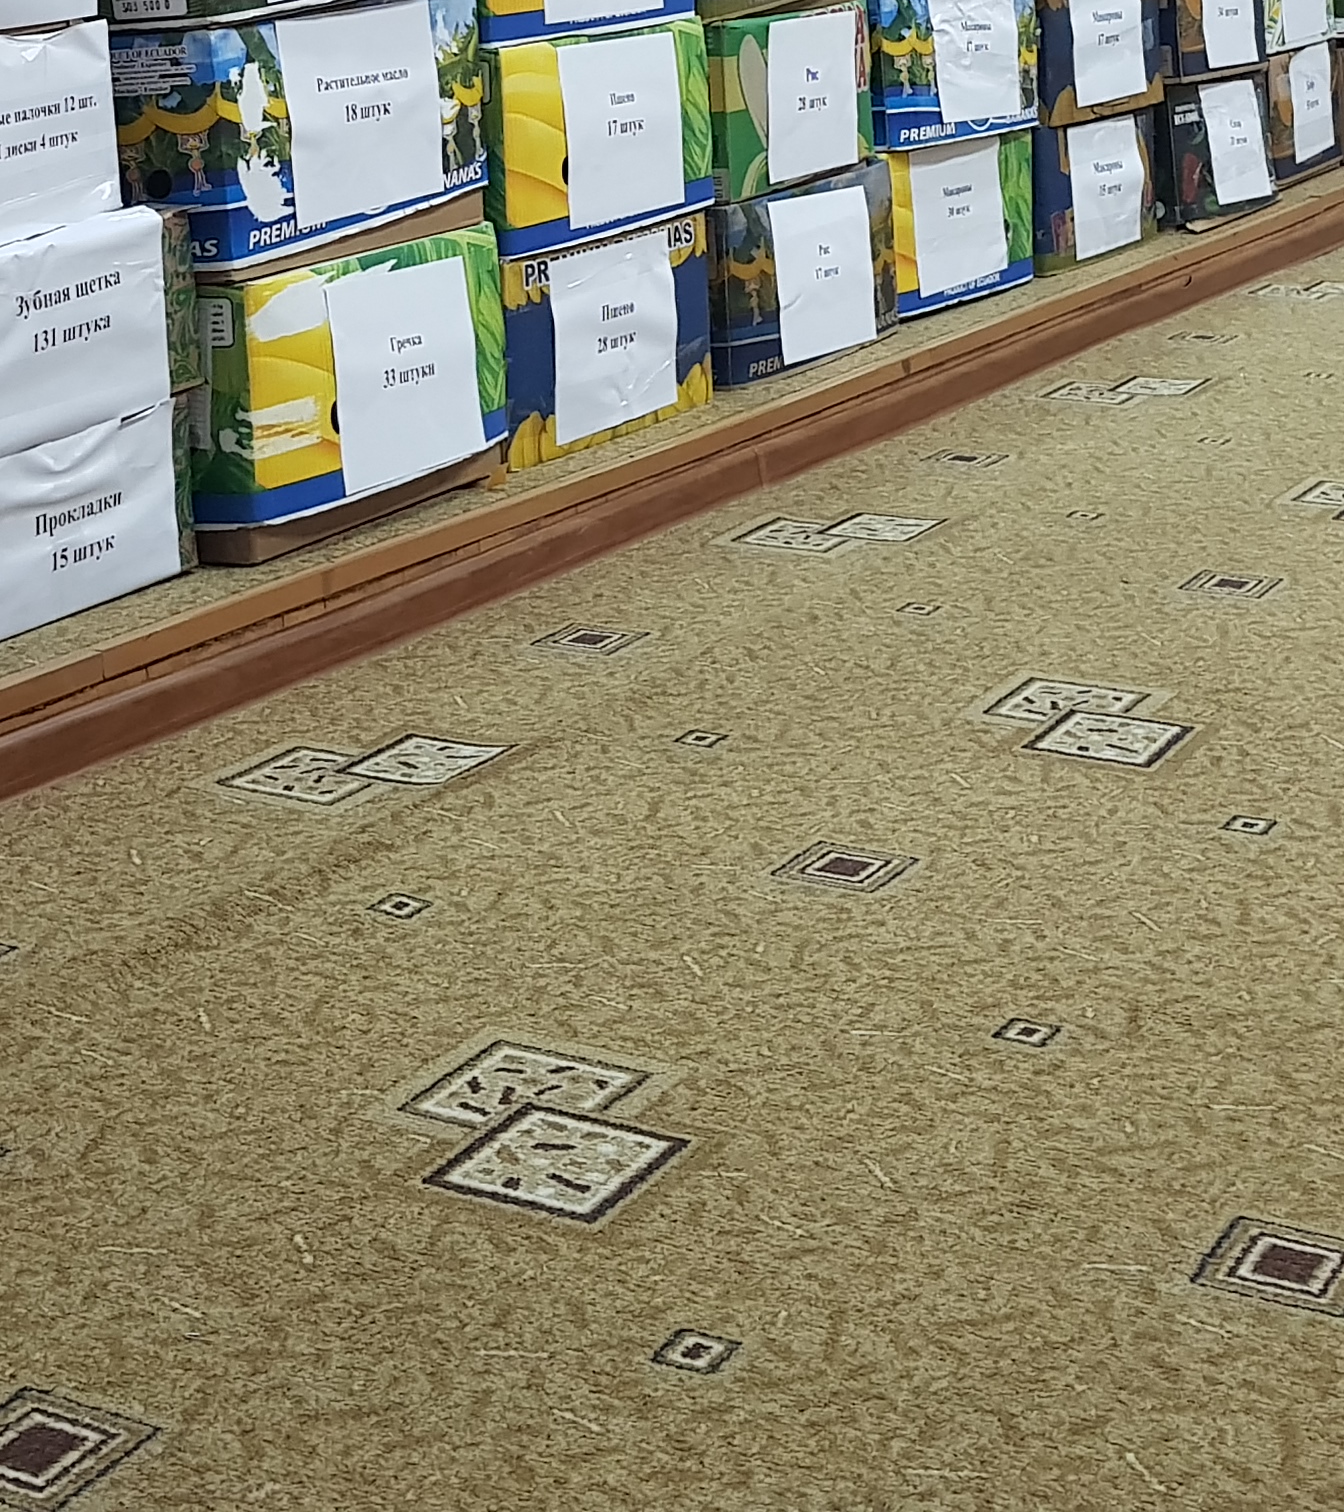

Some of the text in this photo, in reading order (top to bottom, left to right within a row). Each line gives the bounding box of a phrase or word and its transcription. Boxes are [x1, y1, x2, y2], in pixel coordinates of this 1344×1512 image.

[316, 68, 409, 93] Растительное масло
[805, 67, 820, 83] Рис
[13, 102, 61, 124] палочки
[63, 95, 76, 113] 12
[78, 95, 97, 110] шт.
[609, 92, 636, 107] Пшено
[797, 96, 828, 112] 28 штук
[345, 102, 391, 123] 18 штук
[607, 119, 645, 137] 17 штук
[899, 122, 956, 143] PREMIUM
[4, 139, 37, 160] диски
[39, 133, 46, 150] 4
[48, 131, 79, 149] штук
[442, 162, 483, 191] NANAS
[818, 244, 831, 257] Рис
[15, 271, 121, 320] Зубная щетка
[601, 302, 635, 322] Пшено
[34, 314, 111, 353] 131 штука
[389, 335, 423, 355] Гречка
[597, 331, 637, 354] 28 штук
[382, 362, 435, 389] 33 штуки
[34, 490, 123, 540] Прокладки
[52, 535, 115, 572] 15 штук
